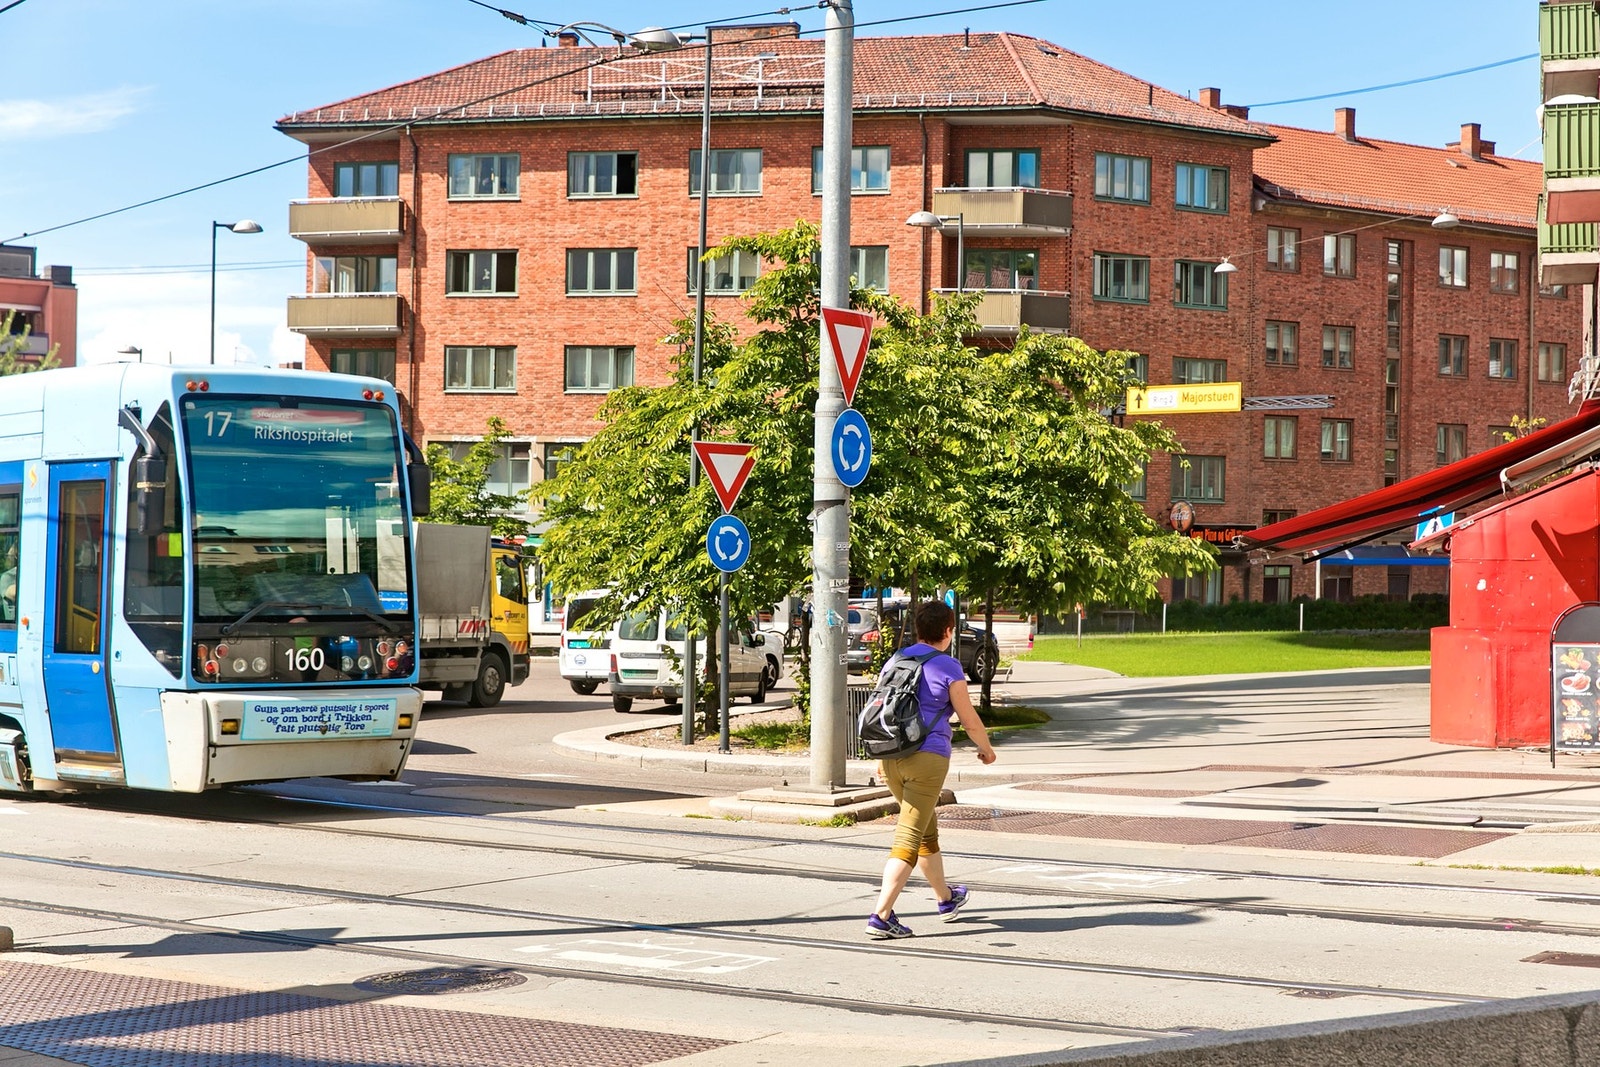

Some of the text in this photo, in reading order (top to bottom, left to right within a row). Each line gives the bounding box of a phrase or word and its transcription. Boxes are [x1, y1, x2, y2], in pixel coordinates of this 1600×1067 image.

[1182, 392, 1234, 405] Majorstuen
[203, 410, 232, 437] 17
[254, 425, 353, 444] Rikshospitalet
[285, 648, 325, 671] 160
[280, 705, 318, 714] parkerte
[320, 704, 357, 713] plutselig
[364, 704, 389, 713] sporet
[266, 716, 279, 725] og
[302, 714, 325, 722] bord
[334, 713, 372, 722] Trikken
[275, 724, 295, 733] falt
[344, 722, 366, 731] Tore
